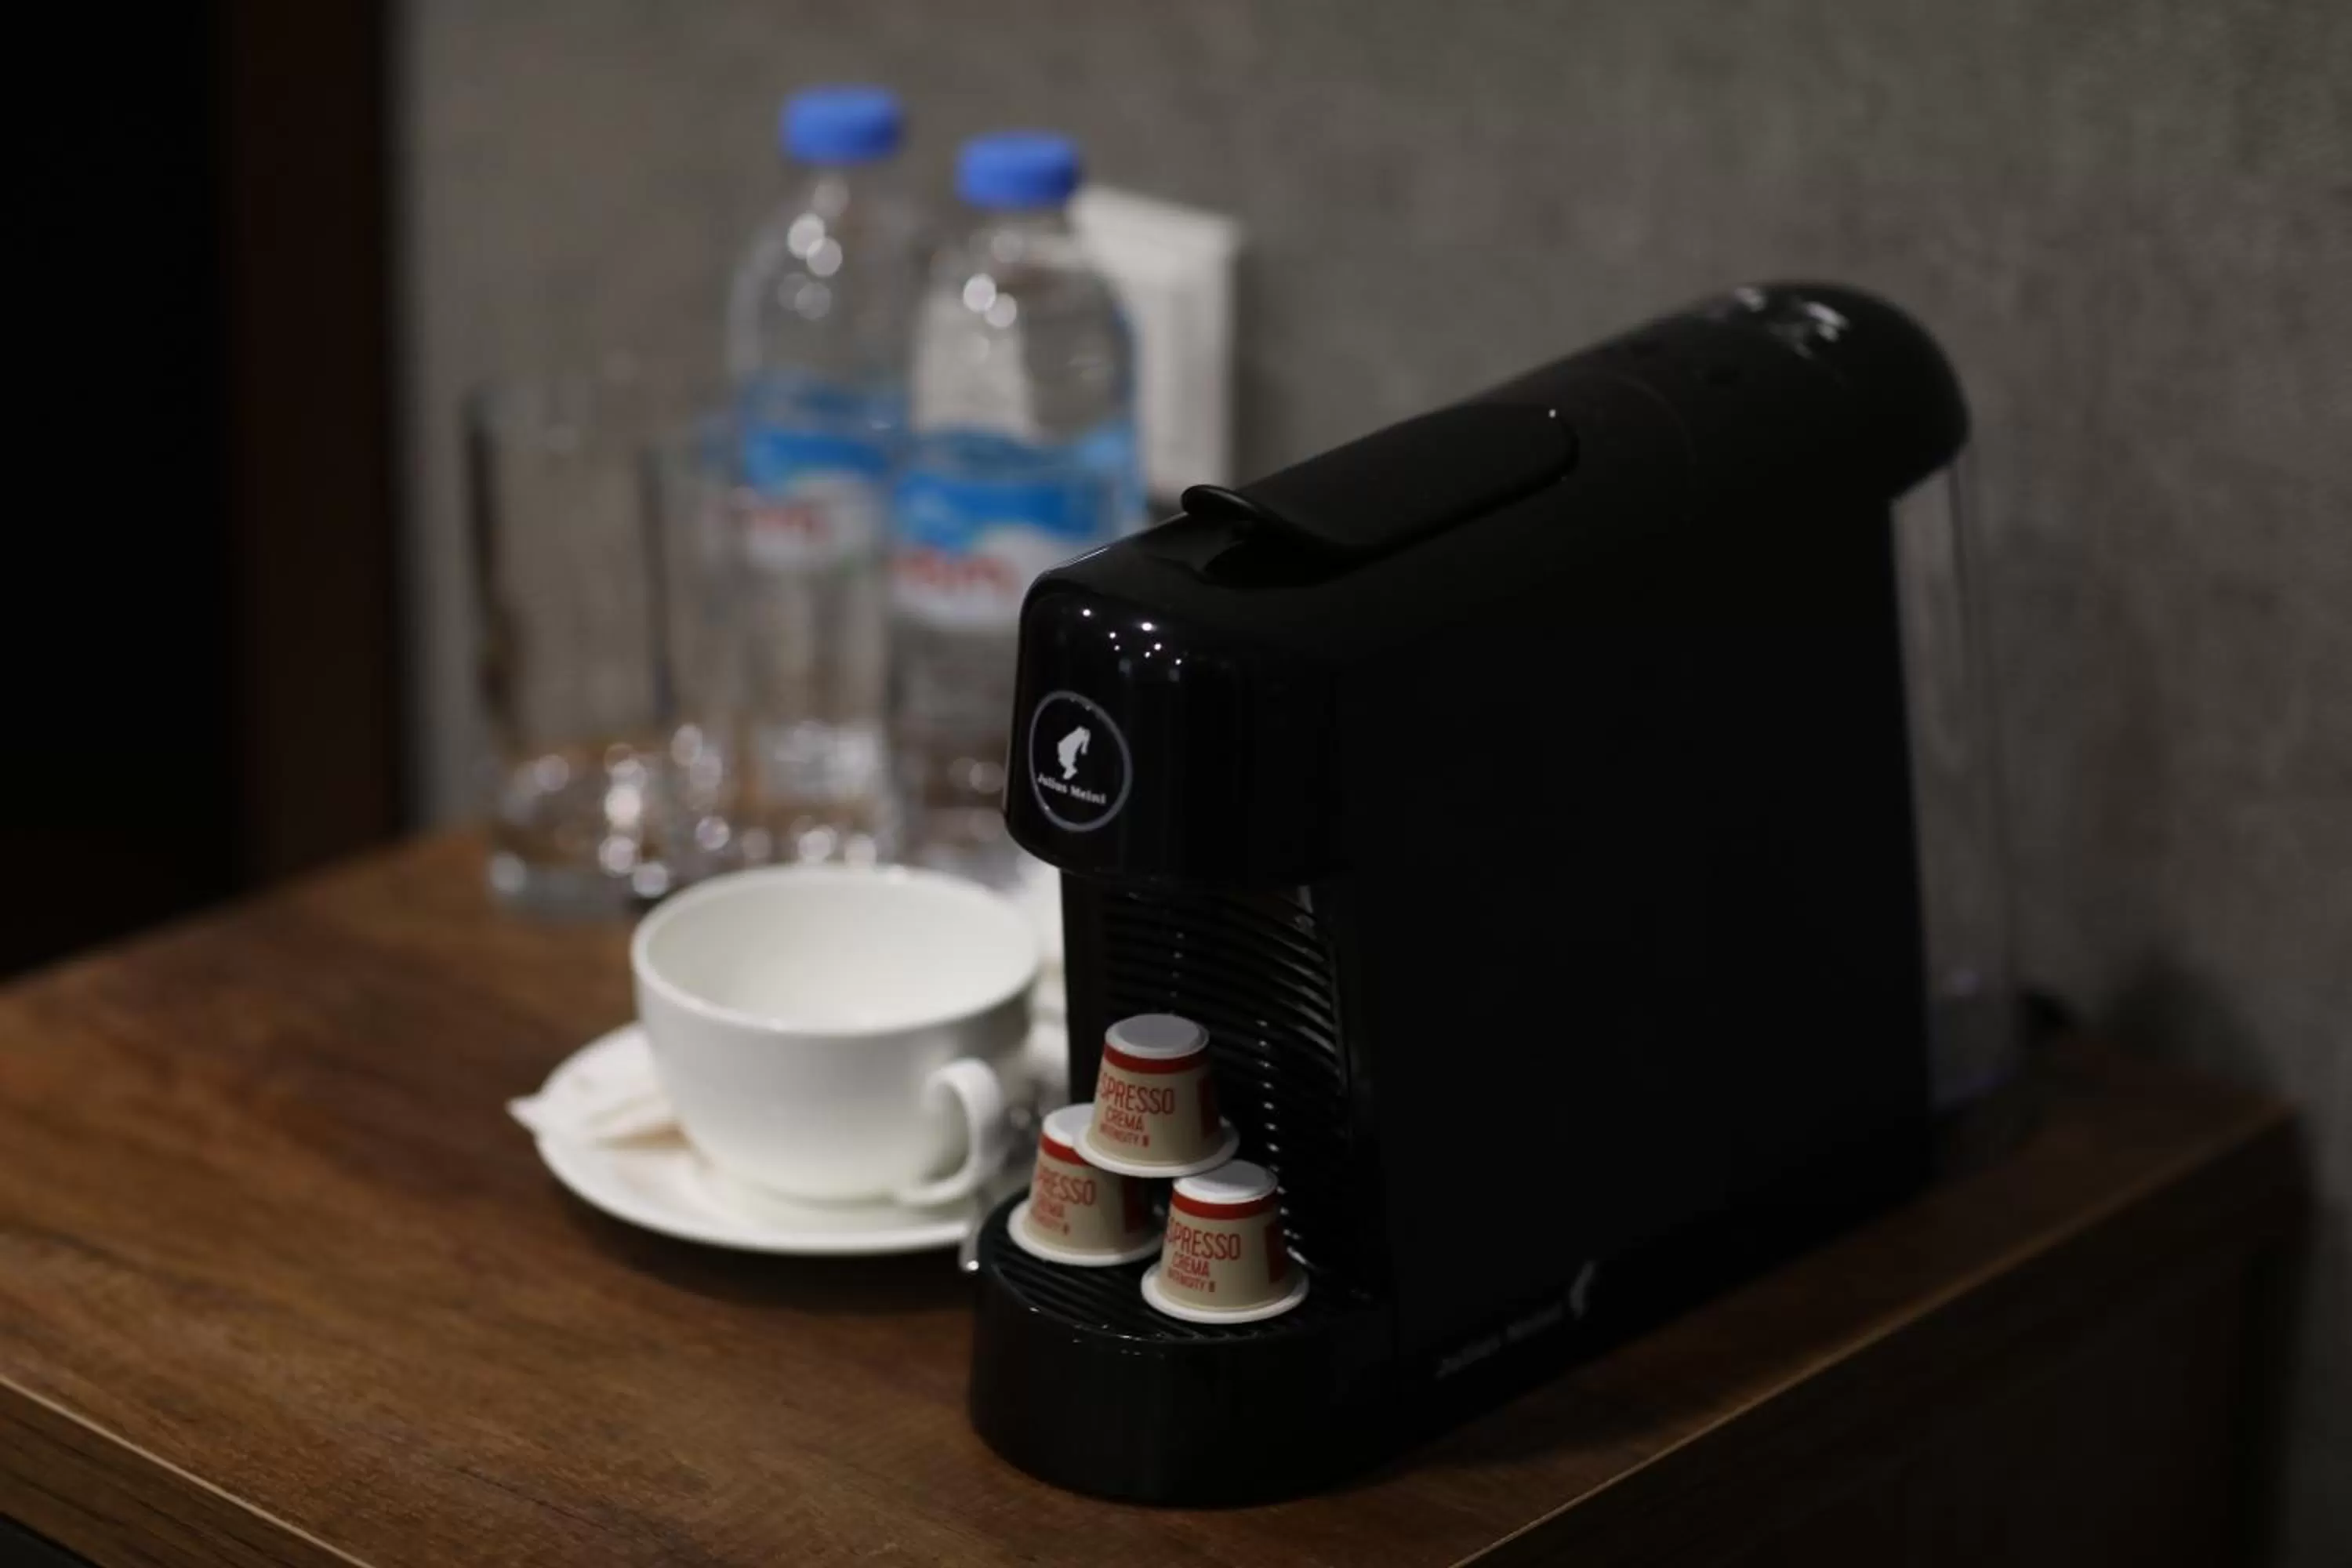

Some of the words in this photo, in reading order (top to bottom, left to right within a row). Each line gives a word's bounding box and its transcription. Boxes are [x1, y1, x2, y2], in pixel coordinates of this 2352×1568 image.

[1099, 1072, 1175, 1115] SPRESSO
[1105, 1105, 1145, 1131] CREMA
[1166, 1217, 1241, 1261] SPRESSO
[1172, 1251, 1210, 1277] CREMA
